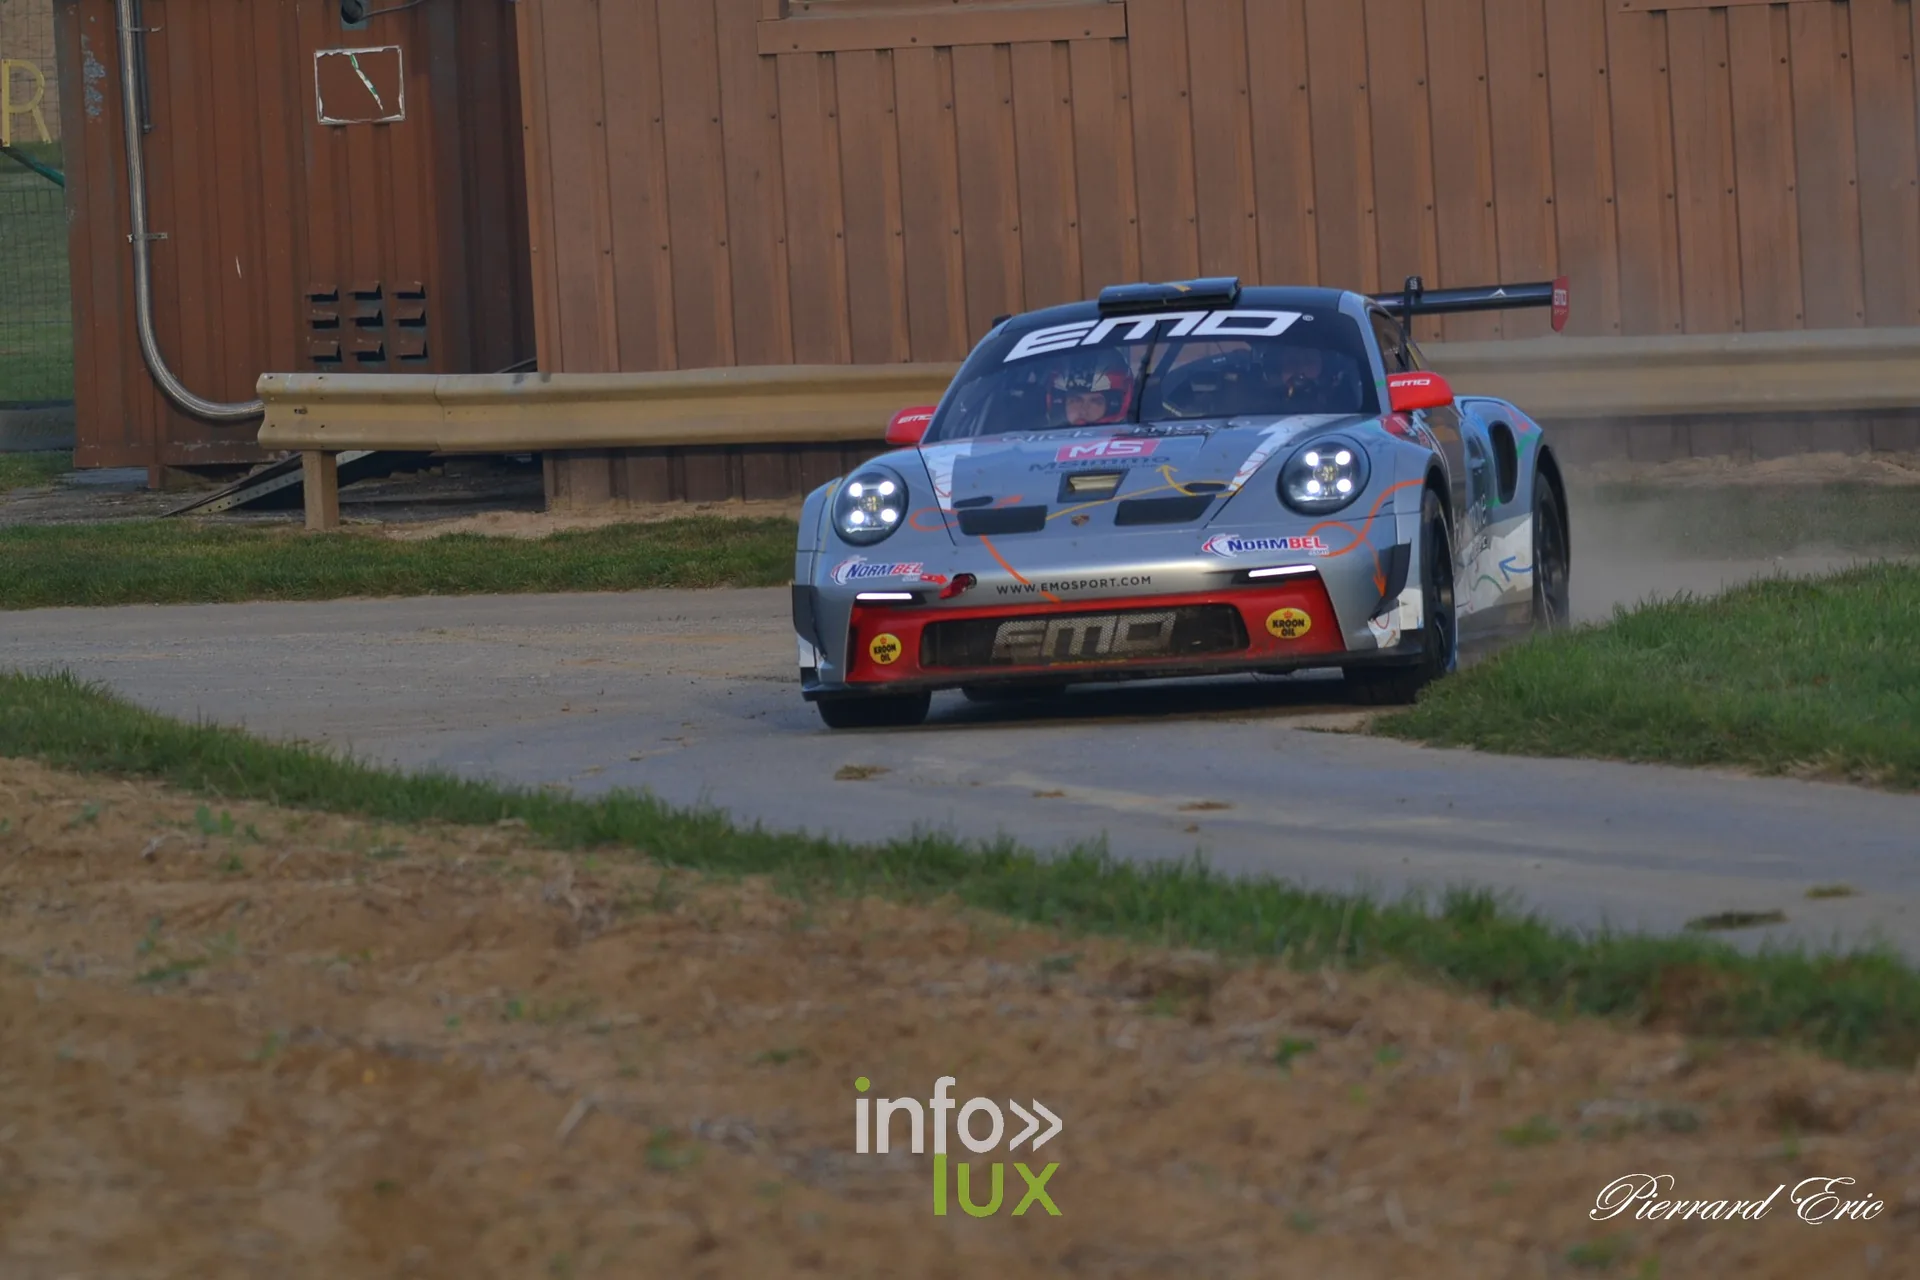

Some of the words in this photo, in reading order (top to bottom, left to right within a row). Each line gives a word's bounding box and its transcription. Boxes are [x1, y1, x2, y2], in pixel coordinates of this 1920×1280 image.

[996, 576, 1151, 595] WWW.EMOSPORT.COM
[1272, 619, 1305, 628] KROON
[1281, 628, 1296, 636] OIL
[873, 643, 896, 654] KROON
